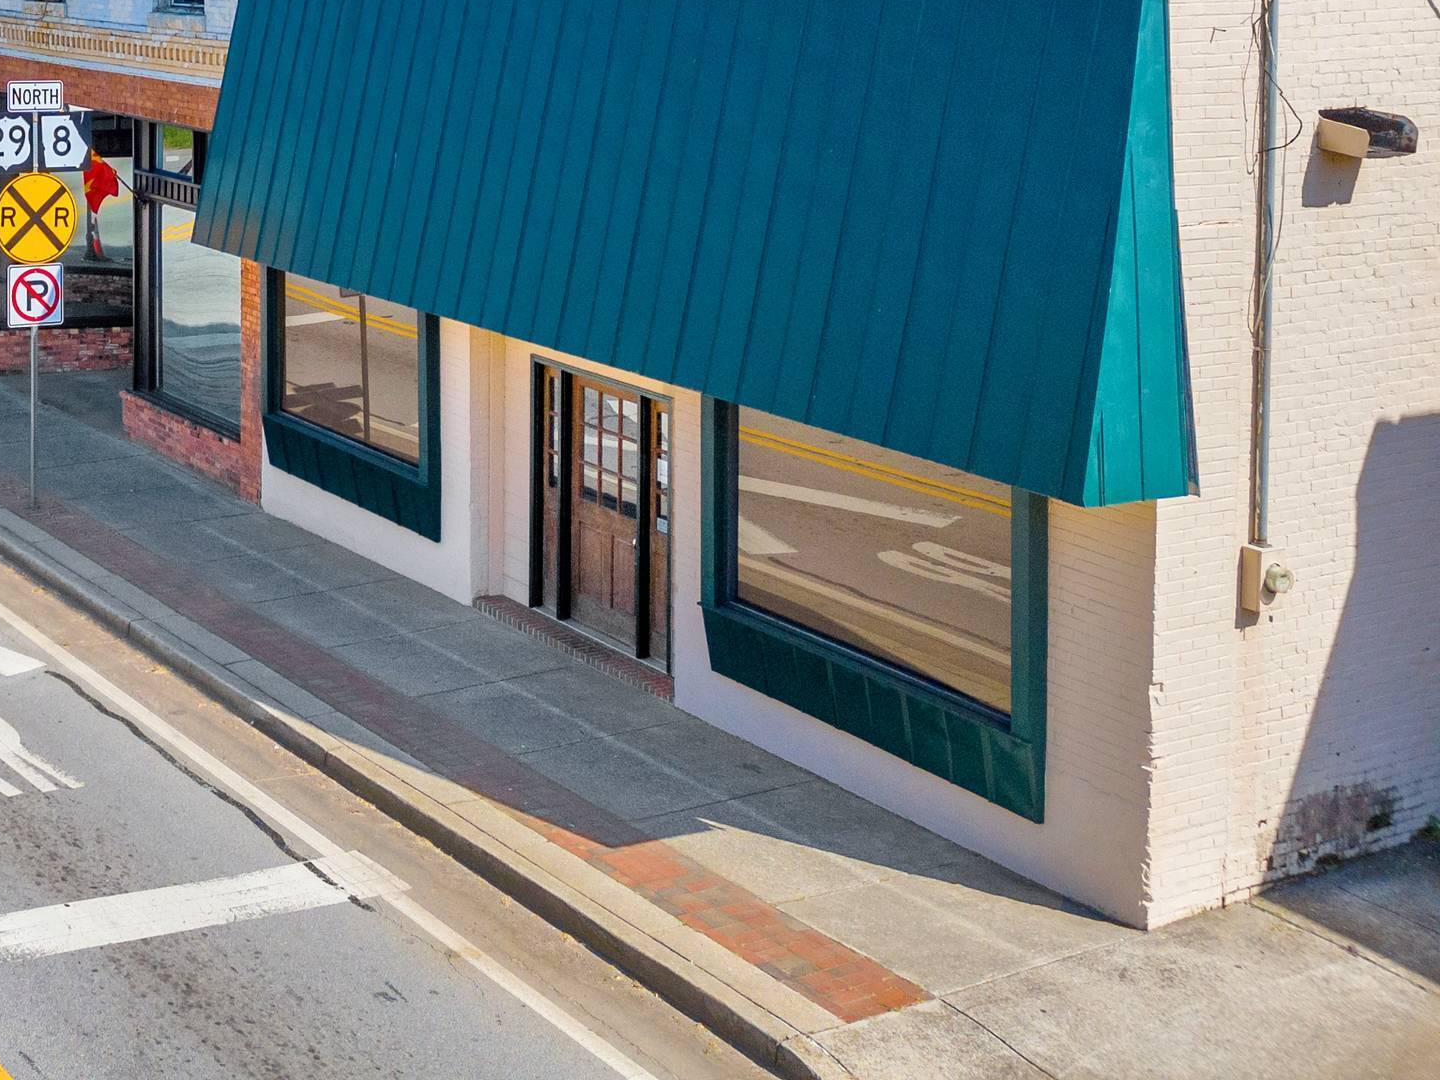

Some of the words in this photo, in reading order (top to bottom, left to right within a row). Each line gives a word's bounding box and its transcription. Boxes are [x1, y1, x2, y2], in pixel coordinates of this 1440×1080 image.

[12, 88, 59, 105] NORTH
[52, 125, 71, 156] 8
[1, 207, 16, 227] R
[54, 207, 69, 227] R
[26, 280, 48, 311] P
